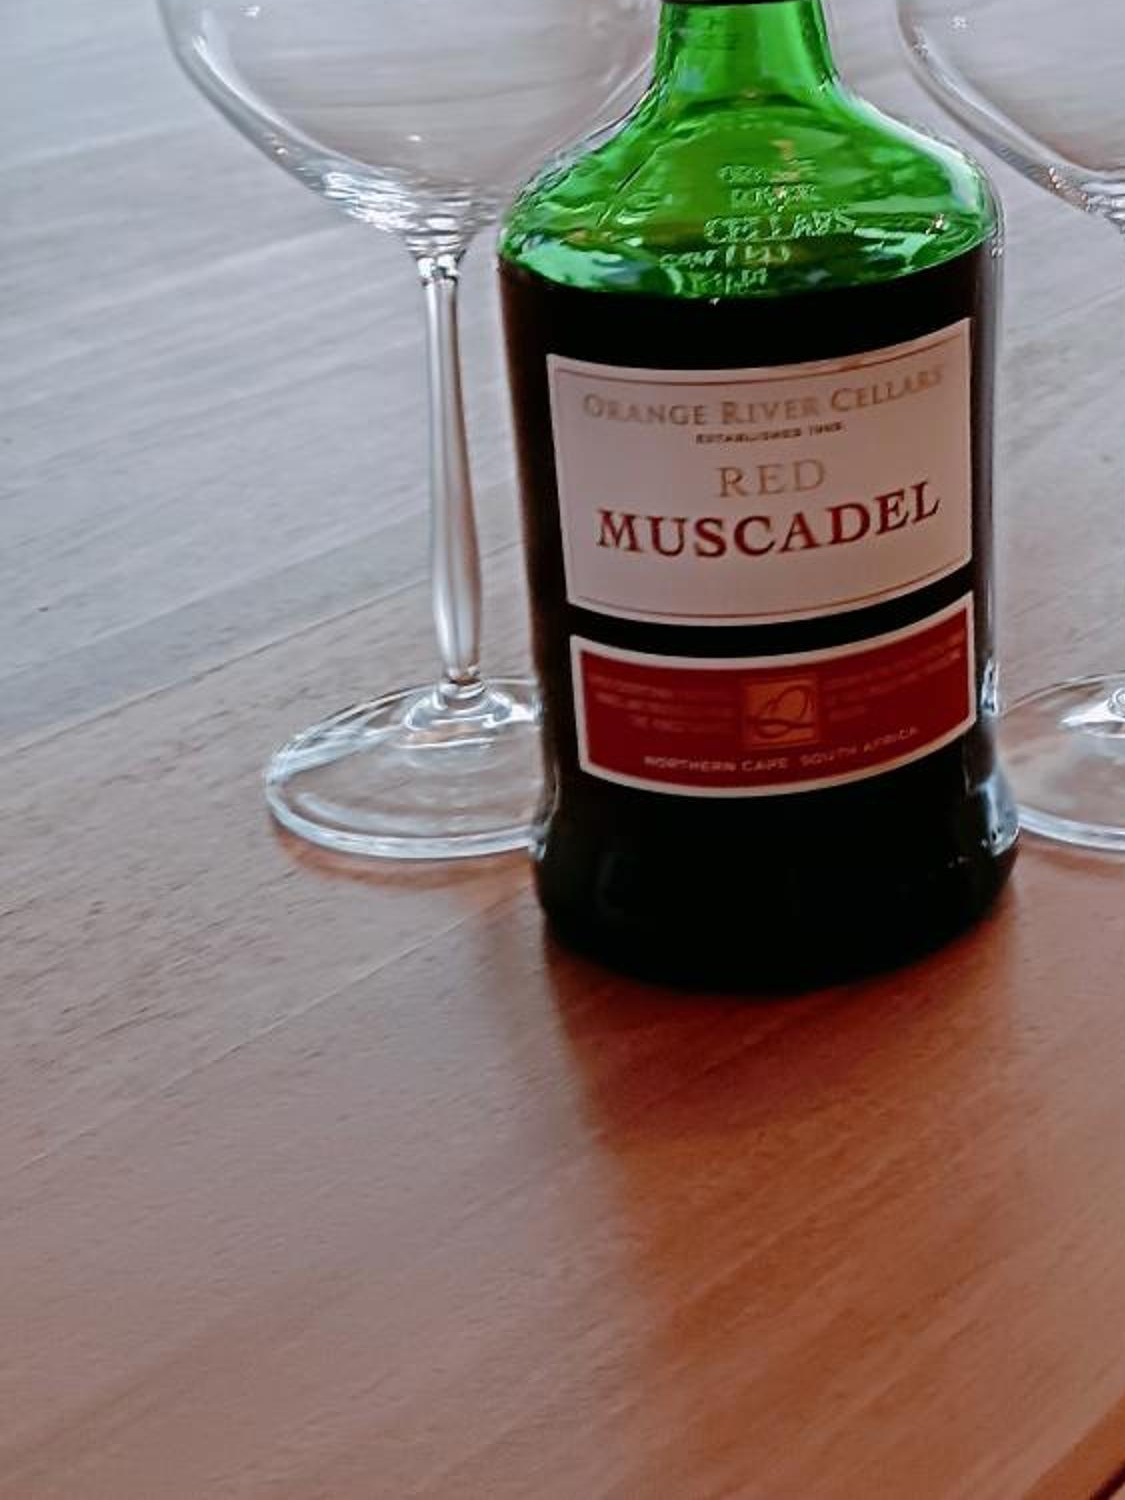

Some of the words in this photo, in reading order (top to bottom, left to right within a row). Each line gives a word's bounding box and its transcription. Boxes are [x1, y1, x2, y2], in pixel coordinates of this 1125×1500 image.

[583, 393, 706, 426] ORANGE
[721, 395, 819, 425] RIVER
[831, 364, 945, 413] CELLARS
[717, 458, 827, 498] RED
[596, 480, 941, 558] MUSCADEL
[643, 755, 737, 773] NORTHERN
[742, 757, 788, 772] CAPE
[799, 745, 858, 767] SOUTH
[863, 726, 919, 752] AFRICA
